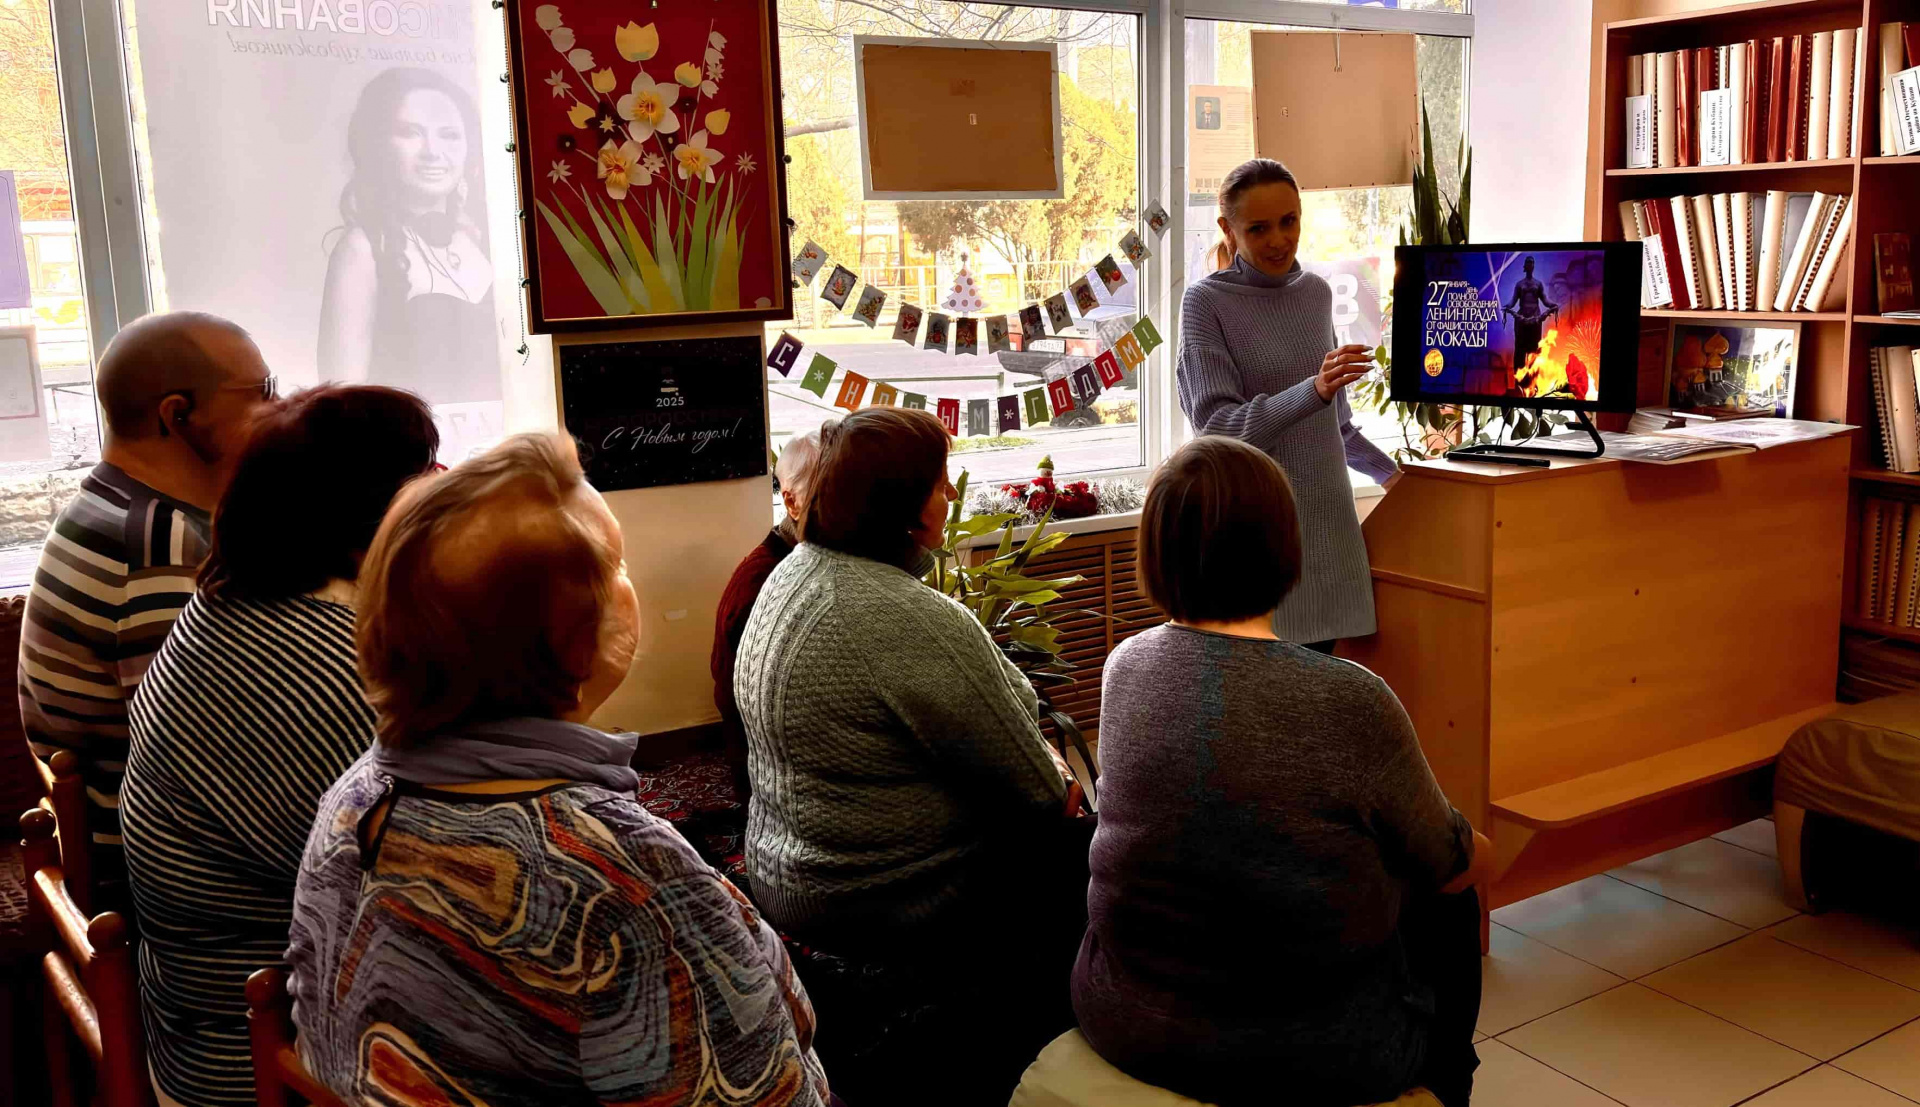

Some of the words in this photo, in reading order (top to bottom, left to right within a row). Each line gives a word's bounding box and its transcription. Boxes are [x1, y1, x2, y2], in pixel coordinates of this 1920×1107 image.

[1426, 281, 1449, 306] 27
[1447, 292, 1479, 301] ПОЛНОГО
[1446, 300, 1498, 309] ОСВОБОЖДЕНИЯ
[1426, 307, 1498, 322] ЛЕНИНГРАДА
[1426, 321, 1437, 330] ОТ
[1437, 320, 1488, 331] ФАШИСТСКОЙ
[1426, 330, 1488, 348] БЛОКАДЫ
[656, 396, 685, 408] 2025
[602, 426, 625, 450] С
[631, 422, 686, 450] Новым
[692, 417, 742, 454] годом!
